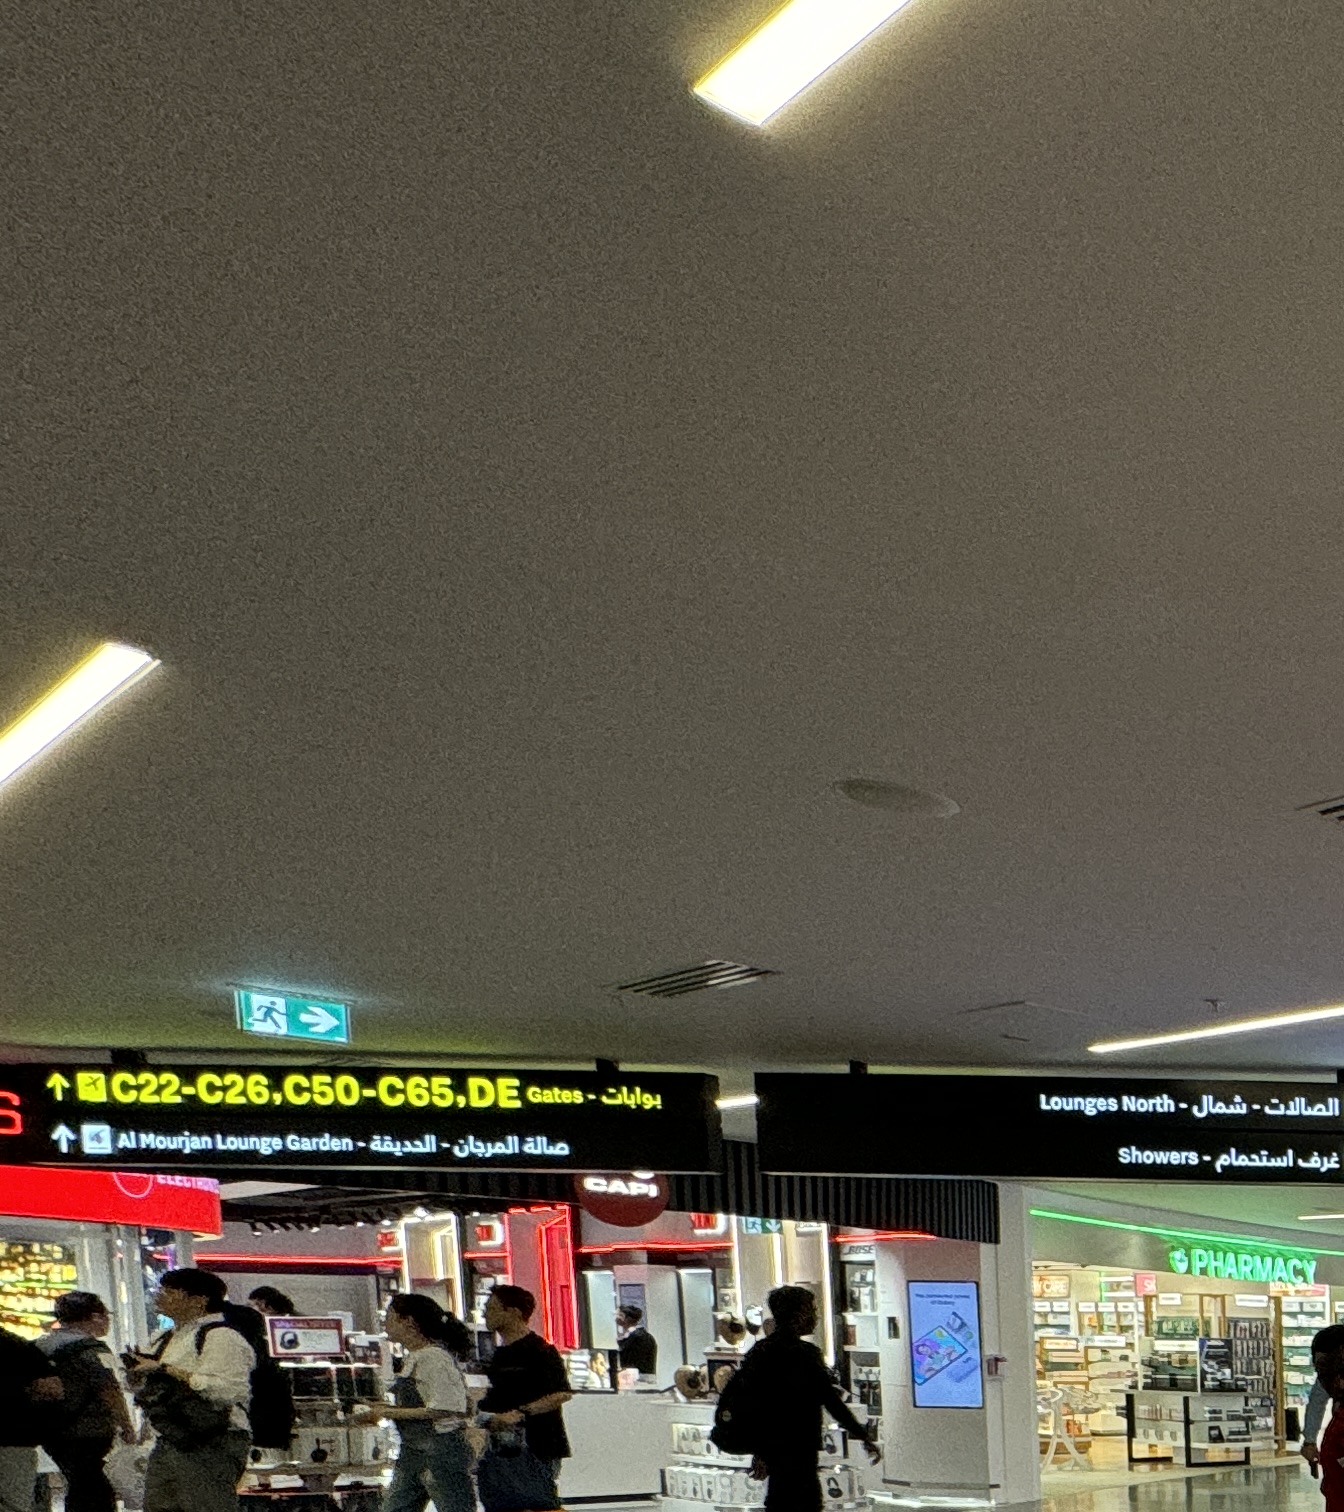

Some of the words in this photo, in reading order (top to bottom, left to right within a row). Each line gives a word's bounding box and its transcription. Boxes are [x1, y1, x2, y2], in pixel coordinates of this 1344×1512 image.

[526, 1086, 584, 1104] Gates
[601, 1086, 663, 1109] بوابات
[1039, 1094, 1119, 1116] Lounges
[1121, 1095, 1176, 1113] North
[1192, 1094, 1247, 1118] شمال
[1264, 1096, 1340, 1117] الصالات
[117, 1131, 137, 1149] Al
[140, 1131, 213, 1154] Mourjan
[216, 1132, 283, 1155] Lounge
[286, 1133, 354, 1151] Garden
[369, 1135, 437, 1157] الحديقة
[452, 1135, 520, 1158] المرجان
[522, 1135, 571, 1156] صالة
[1118, 1145, 1199, 1166] Showers
[1214, 1147, 1294, 1174] استحمام
[1297, 1150, 1341, 1170] غرف
[583, 1176, 659, 1198] CAPI
[1190, 1248, 1318, 1285] PHARMACY
